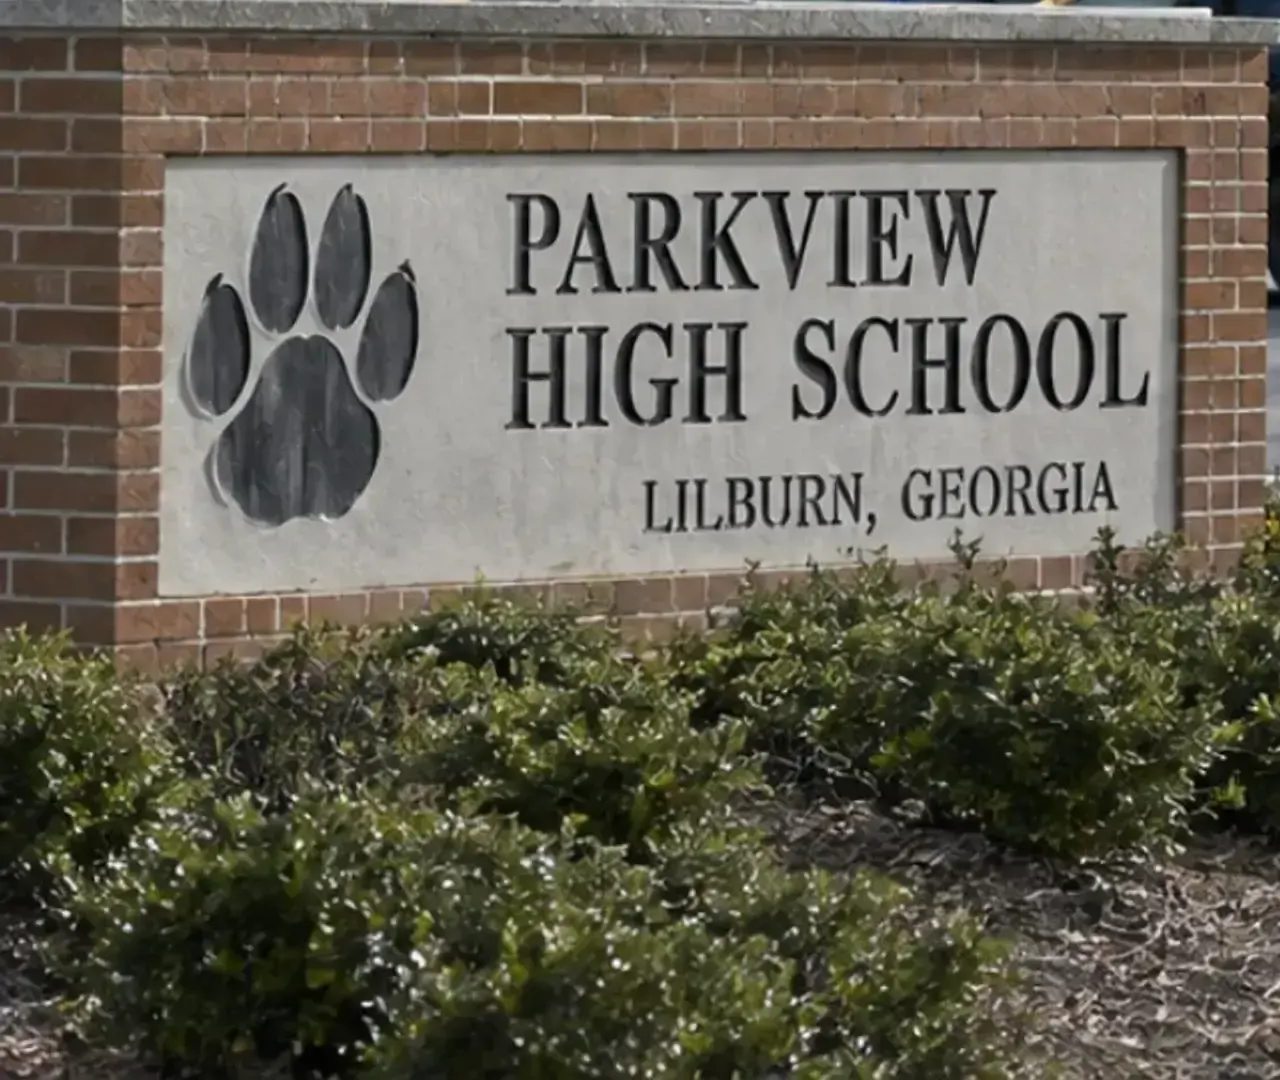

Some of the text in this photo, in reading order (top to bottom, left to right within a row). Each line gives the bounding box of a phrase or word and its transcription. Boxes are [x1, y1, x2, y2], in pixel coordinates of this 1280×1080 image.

[506, 189, 997, 295] PARKVIEW
[506, 311, 1149, 429] HIGH SCHOOL
[644, 460, 1118, 536] LILBURN, GEORGIA
